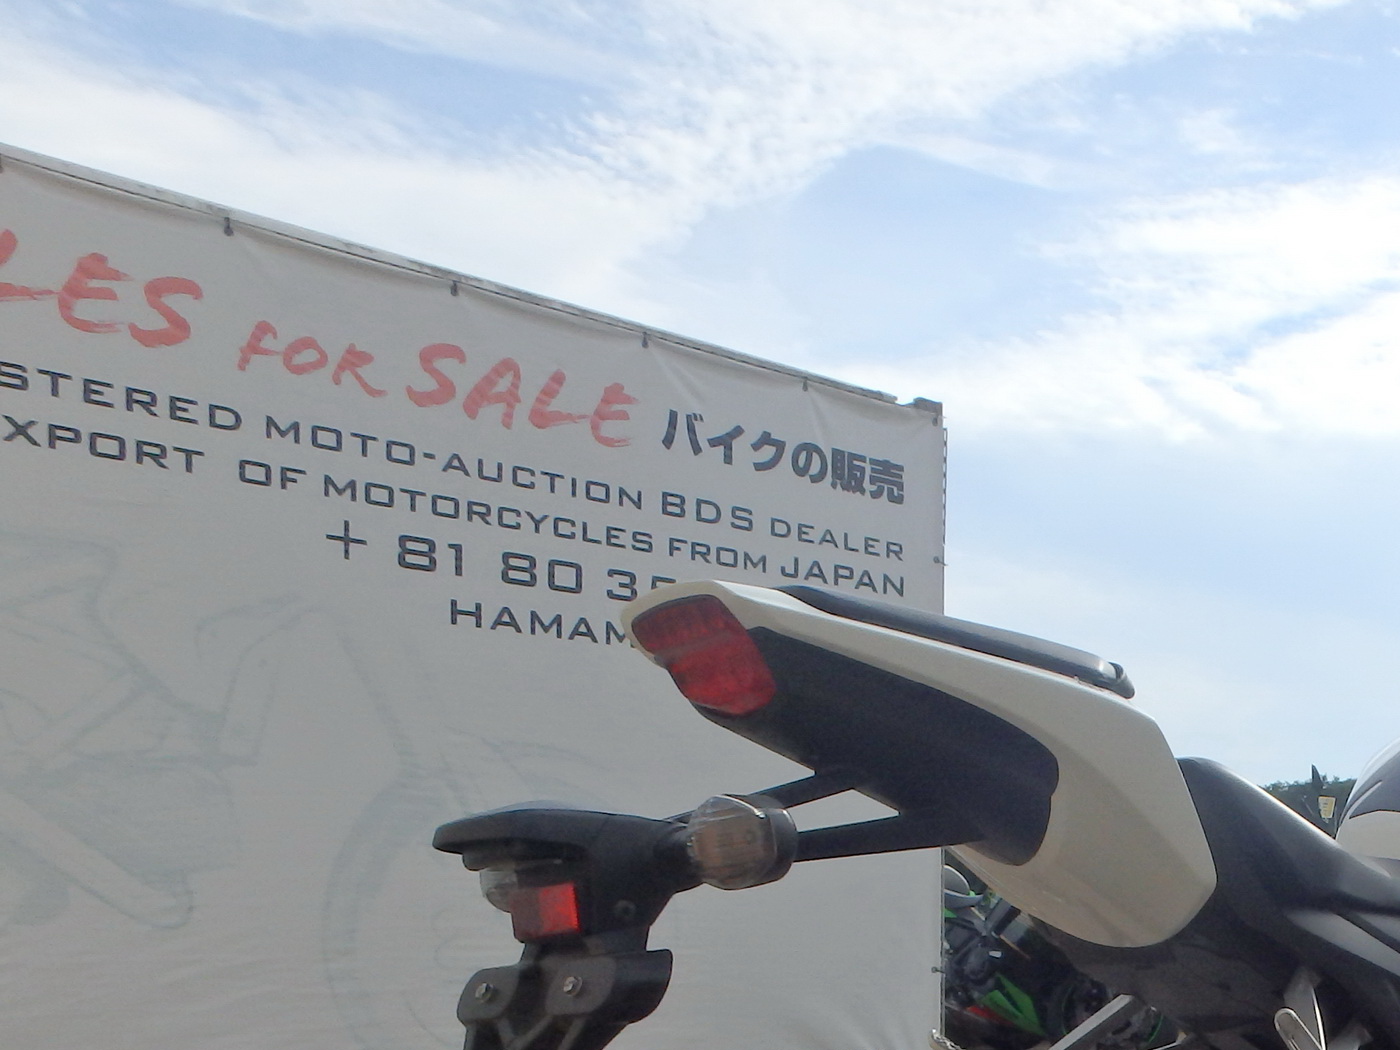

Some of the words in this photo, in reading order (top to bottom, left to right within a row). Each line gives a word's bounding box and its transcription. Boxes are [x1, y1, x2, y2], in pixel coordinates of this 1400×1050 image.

[237, 320, 388, 398] FOR
[405, 343, 638, 448] SALE
[0, 361, 242, 431] STERED
[265, 415, 642, 510] MOTO-AUCTION
[661, 491, 753, 531] BDS
[770, 517, 904, 561] DEALER
[2, 414, 204, 474] XPORT
[239, 459, 306, 490] OF
[324, 474, 653, 553] MOTORCYCLES
[669, 537, 767, 574] FROM
[781, 556, 904, 597] JAPAN
[661, 409, 905, 505] バイクの販売
[398, 534, 462, 577] 81
[501, 551, 583, 594] 80
